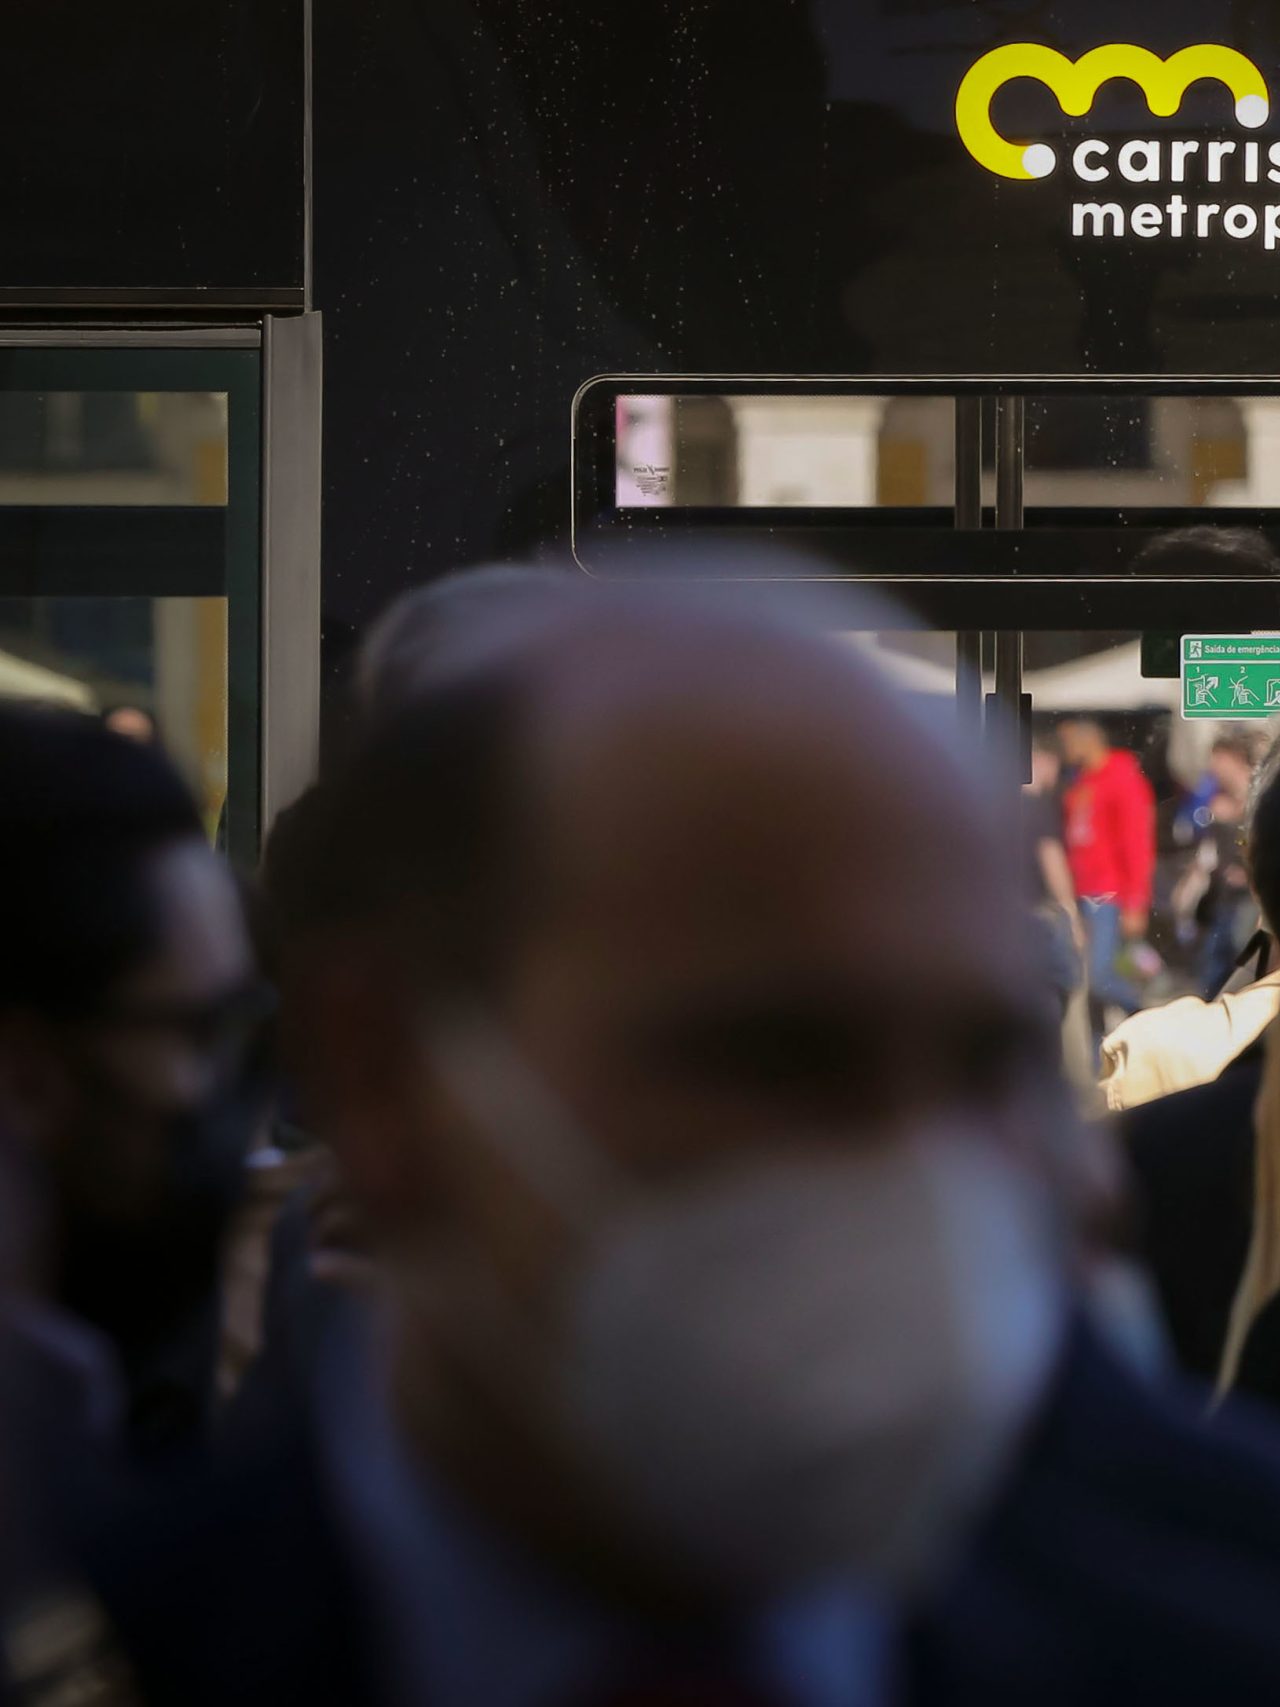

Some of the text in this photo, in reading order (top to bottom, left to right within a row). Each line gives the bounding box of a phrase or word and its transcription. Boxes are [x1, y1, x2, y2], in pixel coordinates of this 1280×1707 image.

[1204, 644, 1280, 656] Saída de emergência
